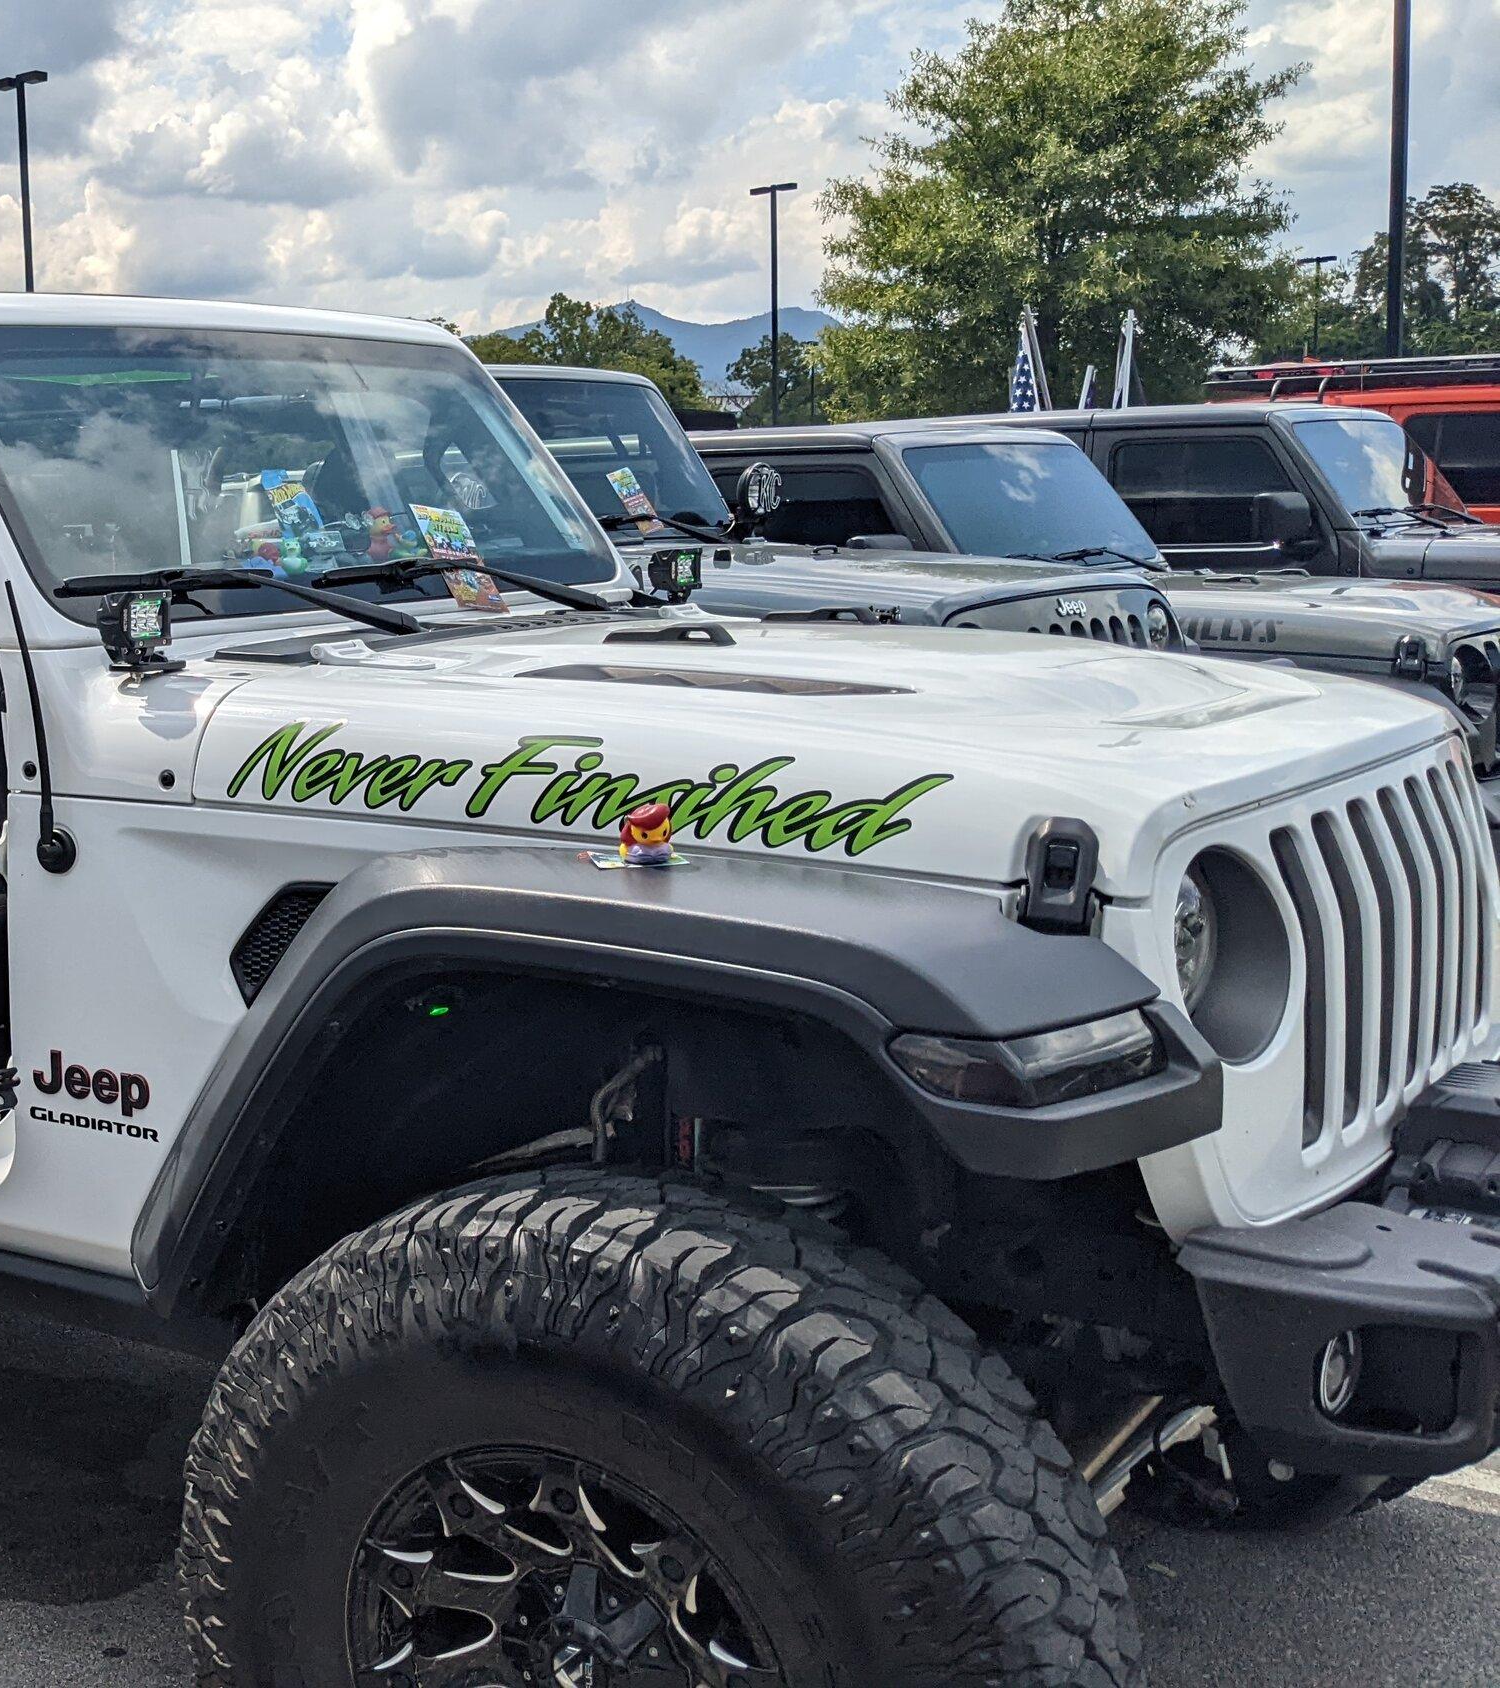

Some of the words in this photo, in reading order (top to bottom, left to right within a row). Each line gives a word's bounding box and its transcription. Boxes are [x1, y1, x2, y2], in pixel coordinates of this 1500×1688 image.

[760, 469, 782, 512] KC
[1055, 598, 1087, 617] Jeep
[1179, 617, 1284, 643] ILLYS
[227, 719, 473, 812] Never
[33, 1050, 151, 1118] Jeep
[30, 1106, 160, 1143] GLADIATOR
